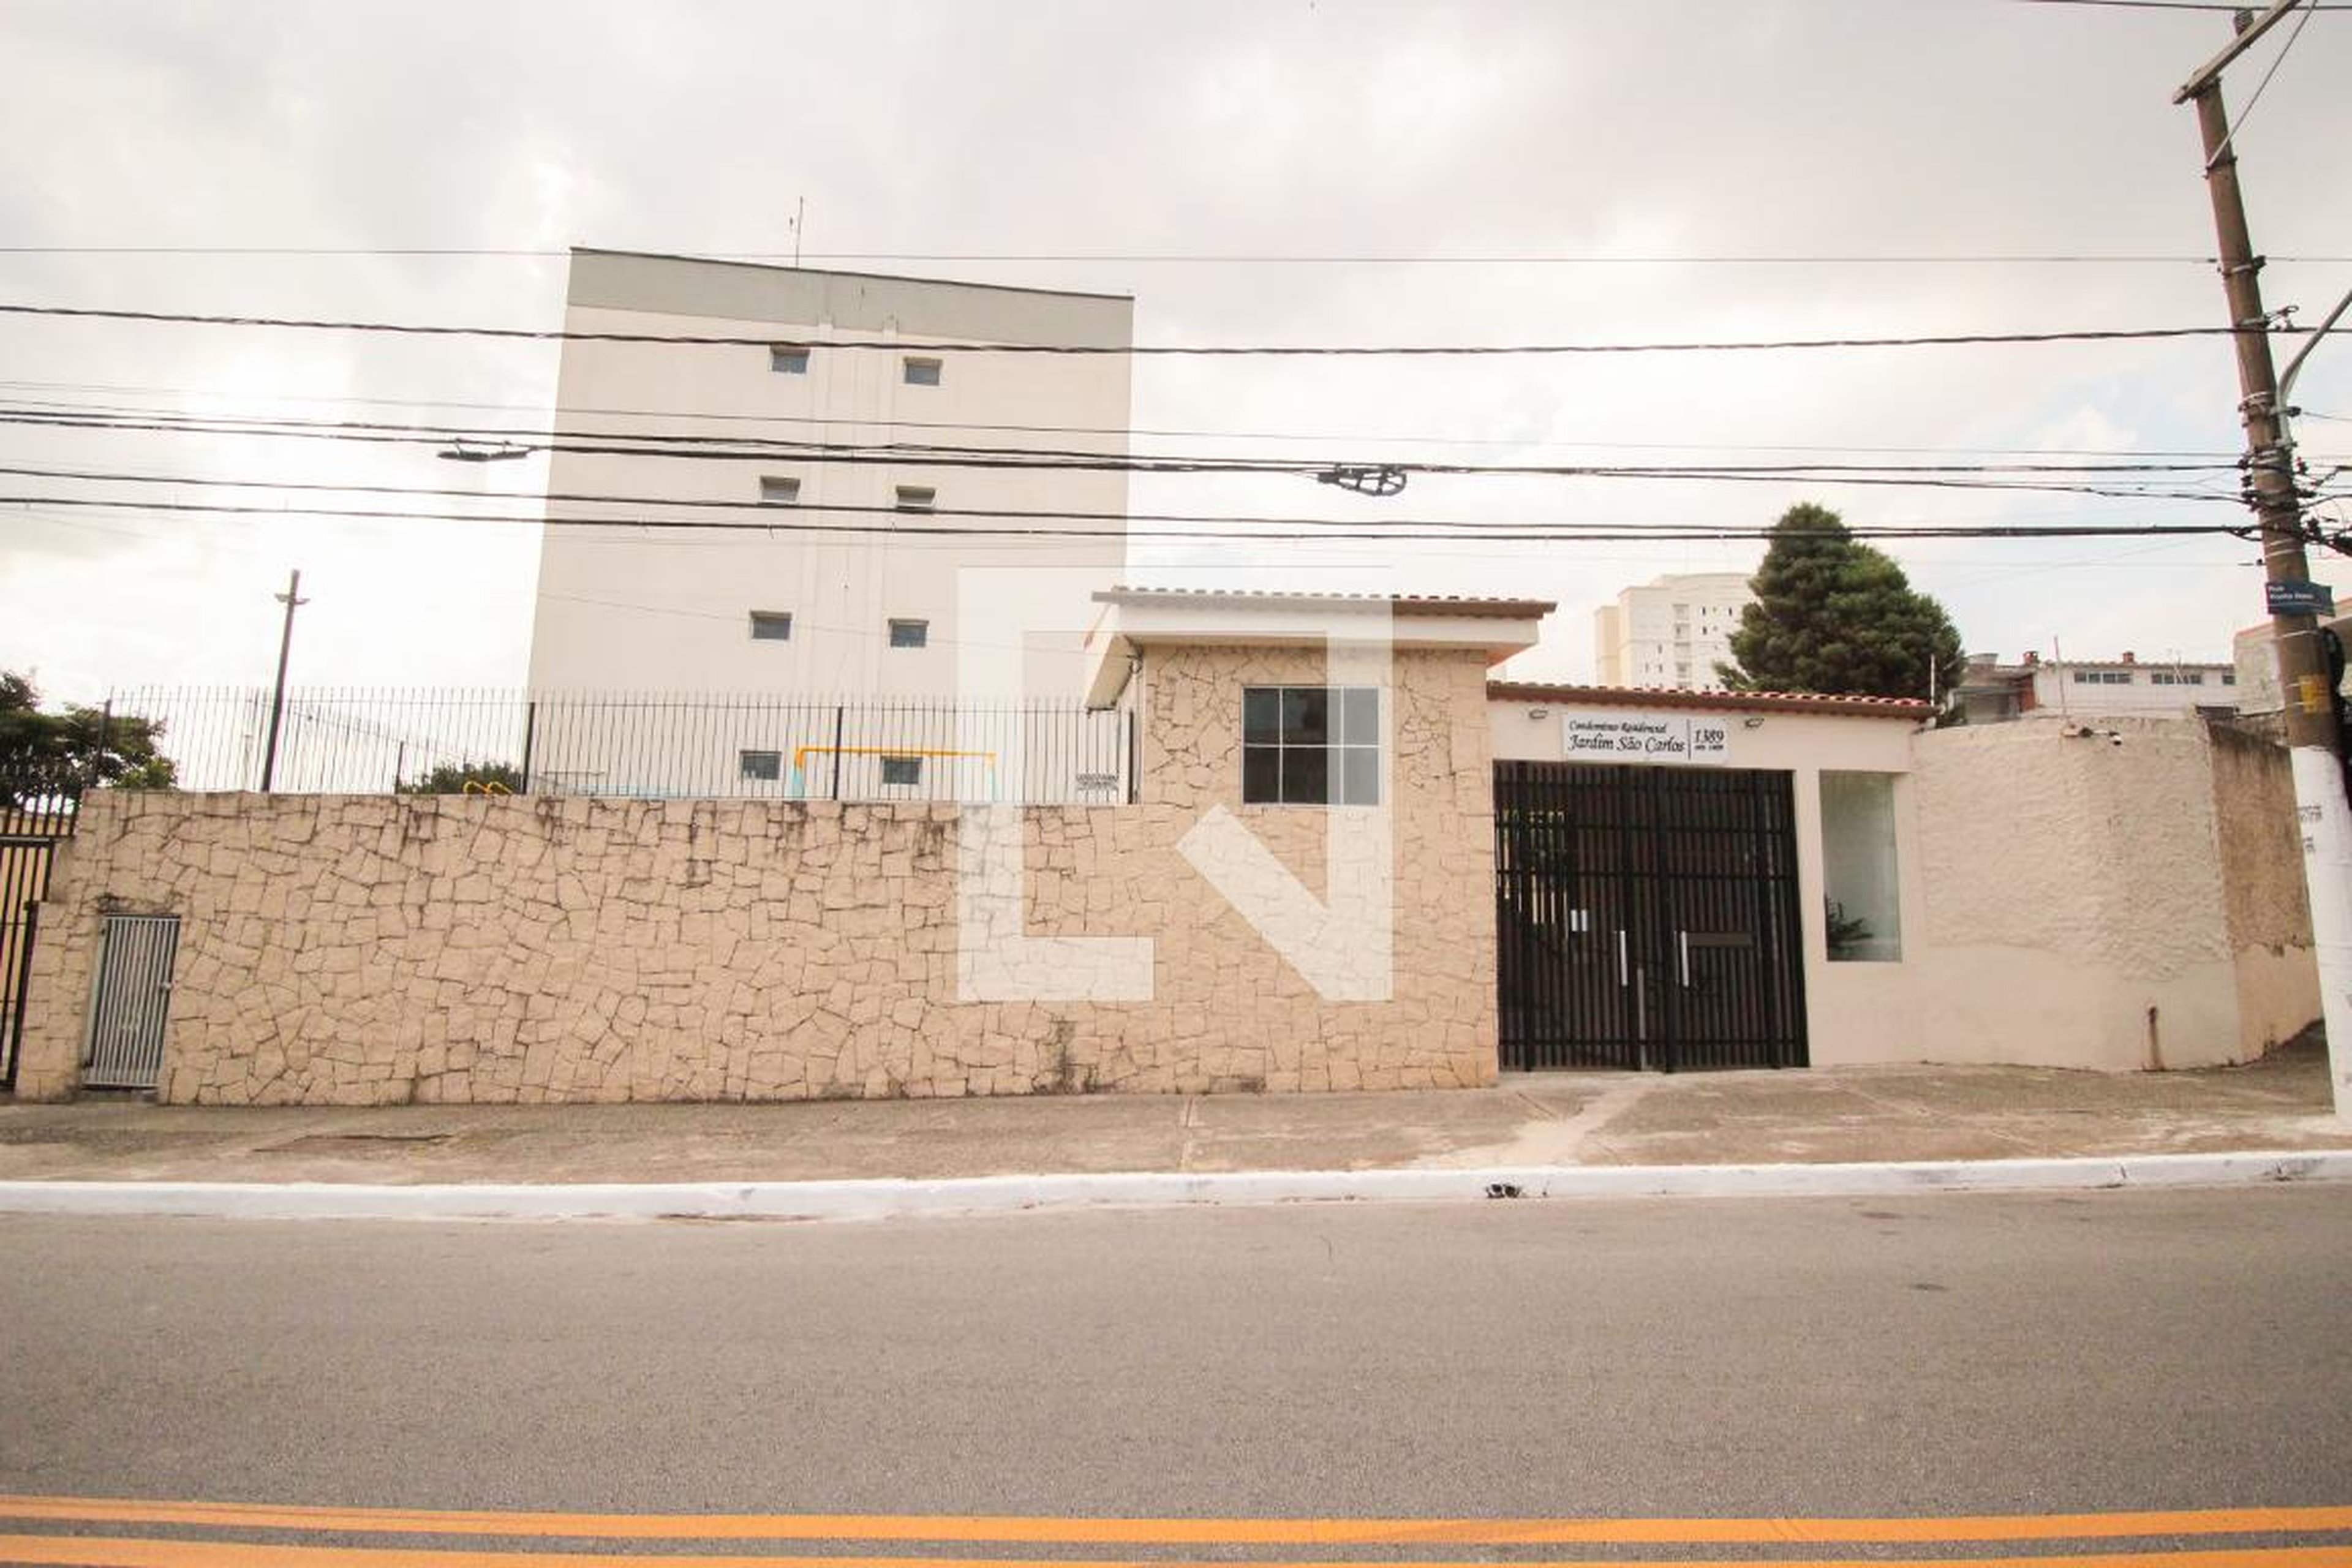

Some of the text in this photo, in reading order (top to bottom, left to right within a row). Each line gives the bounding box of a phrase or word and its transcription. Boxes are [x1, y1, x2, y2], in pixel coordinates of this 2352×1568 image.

[1568, 733, 1685, 753] Jardim São Carlos
[1695, 729, 1724, 744] 1389
